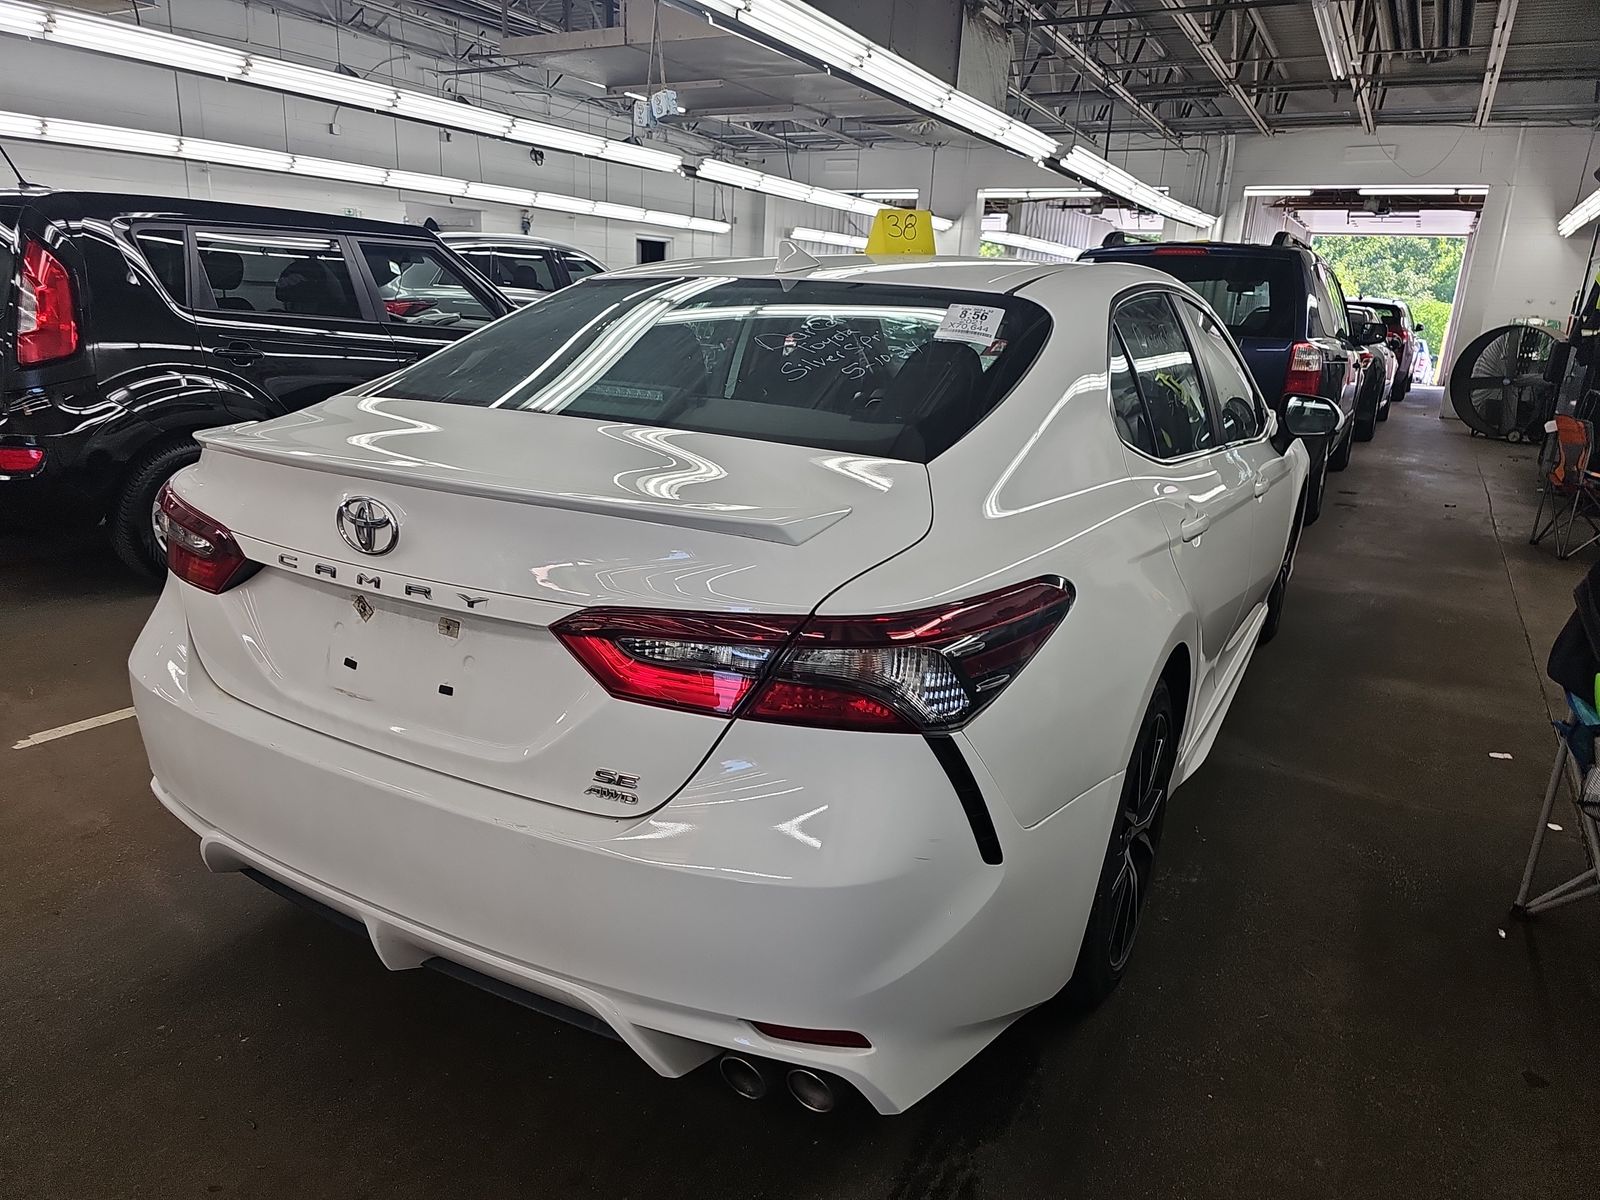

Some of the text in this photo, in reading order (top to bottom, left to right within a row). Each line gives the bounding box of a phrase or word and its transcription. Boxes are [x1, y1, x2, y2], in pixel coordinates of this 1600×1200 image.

[887, 214, 917, 241] 38
[959, 310, 988, 321] 8:56
[781, 350, 846, 381] Silver
[278, 554, 490, 608] CAMRY
[592, 768, 640, 789] SE
[583, 785, 638, 805] AWD
